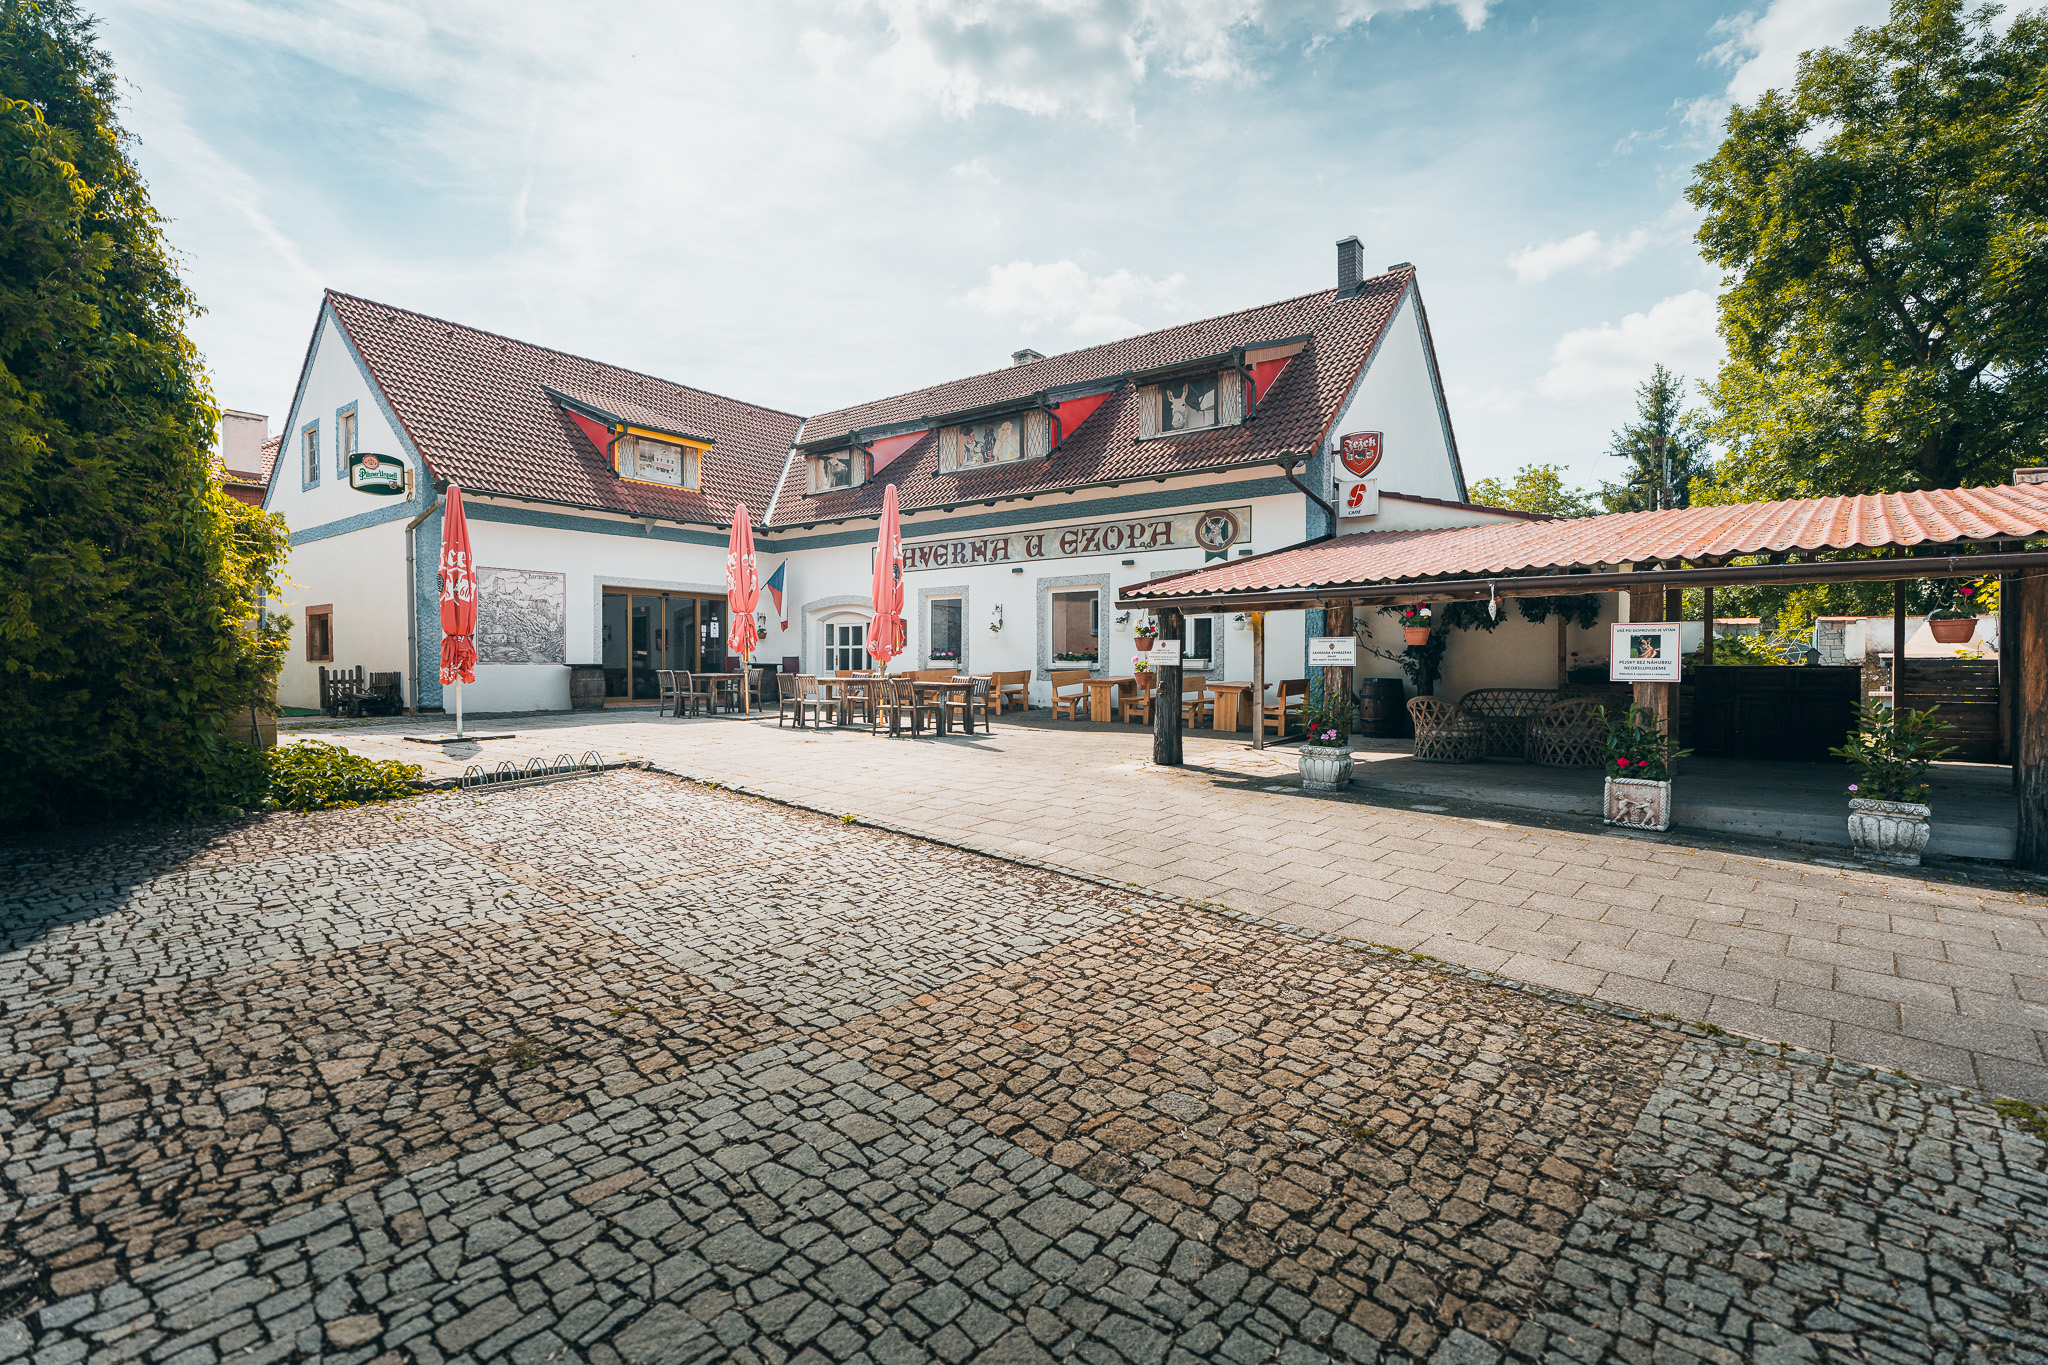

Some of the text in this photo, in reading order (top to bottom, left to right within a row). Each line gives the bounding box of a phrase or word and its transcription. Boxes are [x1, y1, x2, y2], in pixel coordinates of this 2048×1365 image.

[1344, 437, 1376, 452] Ježek
[359, 468, 397, 480] Pilsner Urquell
[902, 538, 1010, 569] AVERNA
[1024, 534, 1044, 558] U
[1060, 521, 1174, 554] EZOPA
